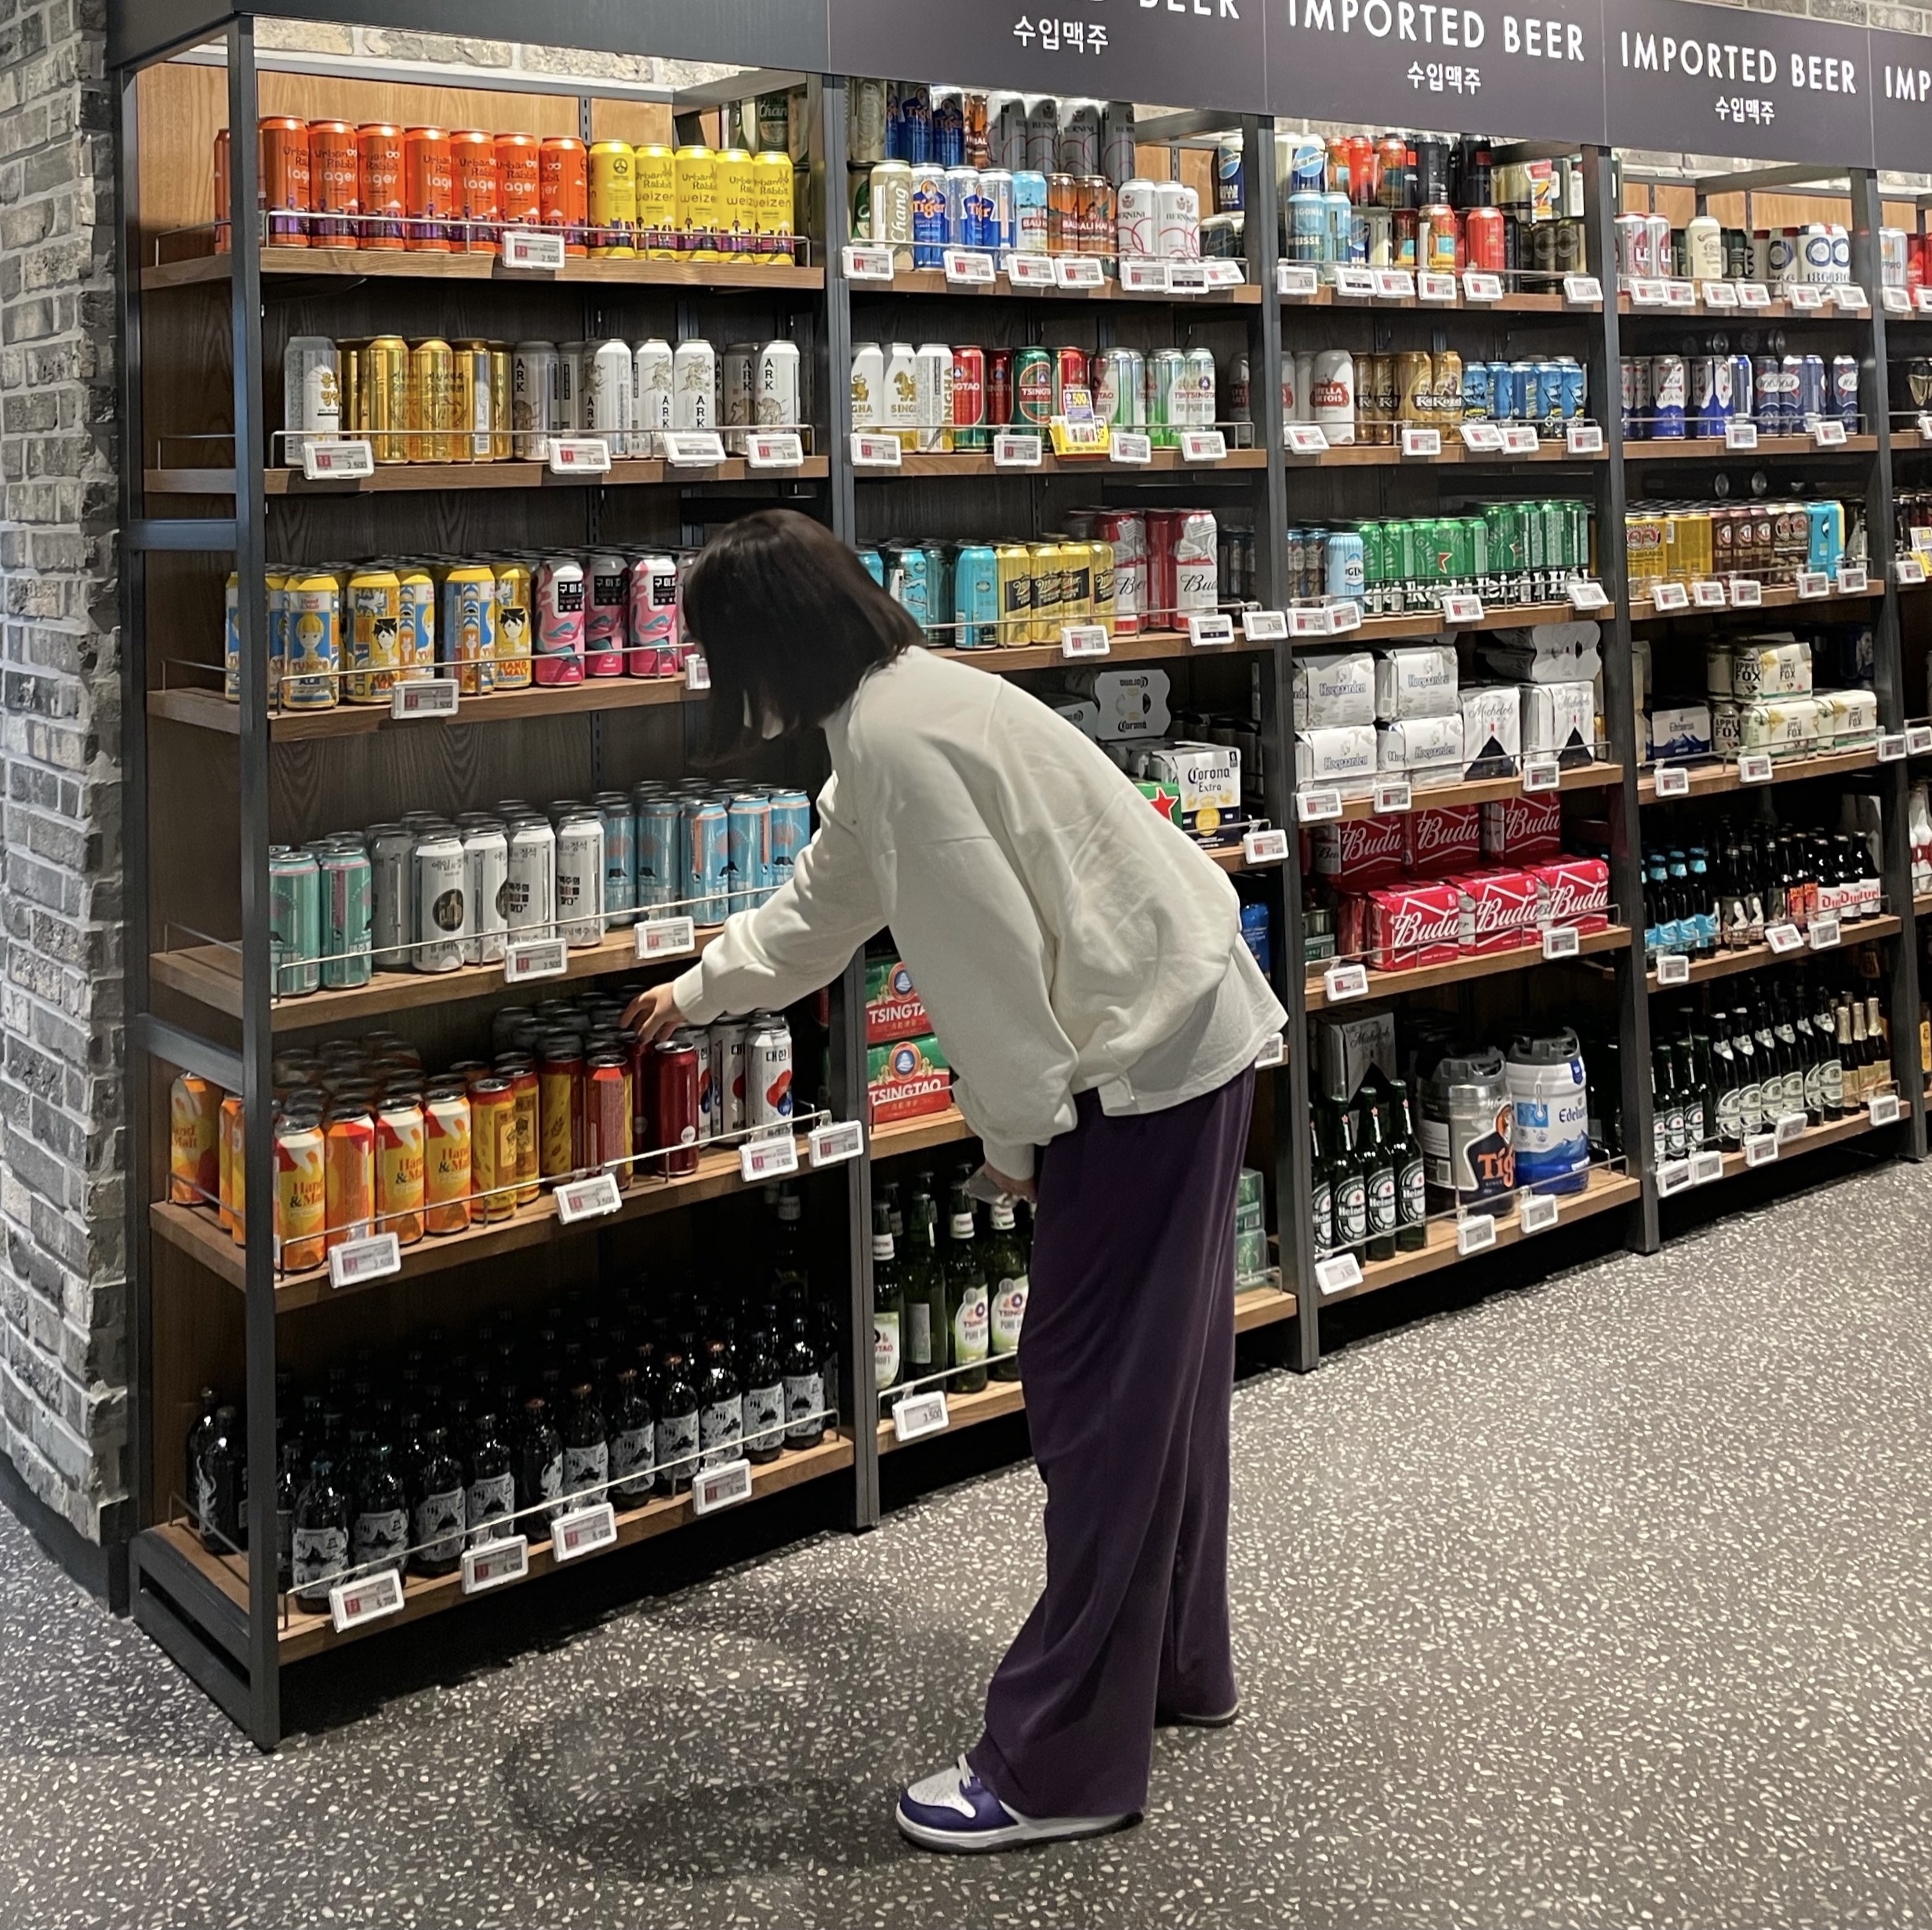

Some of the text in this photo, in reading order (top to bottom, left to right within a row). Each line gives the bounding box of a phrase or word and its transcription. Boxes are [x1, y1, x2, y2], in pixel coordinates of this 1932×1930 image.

[1012, 15, 1109, 55] 수입맥주
[1287, 0, 1484, 48] IMPORTED
[1504, 16, 1585, 62] BEER
[1621, 31, 1858, 94] IMPORTED BEER
[1407, 60, 1482, 95] 수입맥주
[1715, 96, 1775, 125] 수입맥주
[464, 176, 496, 193] lage
[890, 187, 910, 243] Chang
[913, 200, 946, 218] Tiger
[514, 358, 526, 393] ARK
[742, 358, 754, 392] ARK
[764, 358, 775, 391] ARK
[943, 366, 953, 423] INGHA
[695, 394, 706, 429] ARK
[1780, 661, 1796, 672] APPLE
[1407, 673, 1450, 689] Hoegaarden
[1735, 671, 1761, 682] FOX
[1780, 671, 1796, 681] FOX
[1319, 680, 1367, 697] Hoegaarden
[1468, 700, 1514, 719] Michelob
[1117, 720, 1147, 733] Corona
[1715, 727, 1741, 738] FOX
[1848, 718, 1863, 729] FOX
[1787, 729, 1803, 739] FOX
[1414, 742, 1456, 760] Hoegaarden
[1324, 754, 1368, 771] Hoegaarden
[1186, 765, 1231, 786] Corona
[1197, 782, 1222, 793] Extra
[765, 1049, 788, 1063] 대한
[869, 1078, 942, 1104] TSINGTAO
